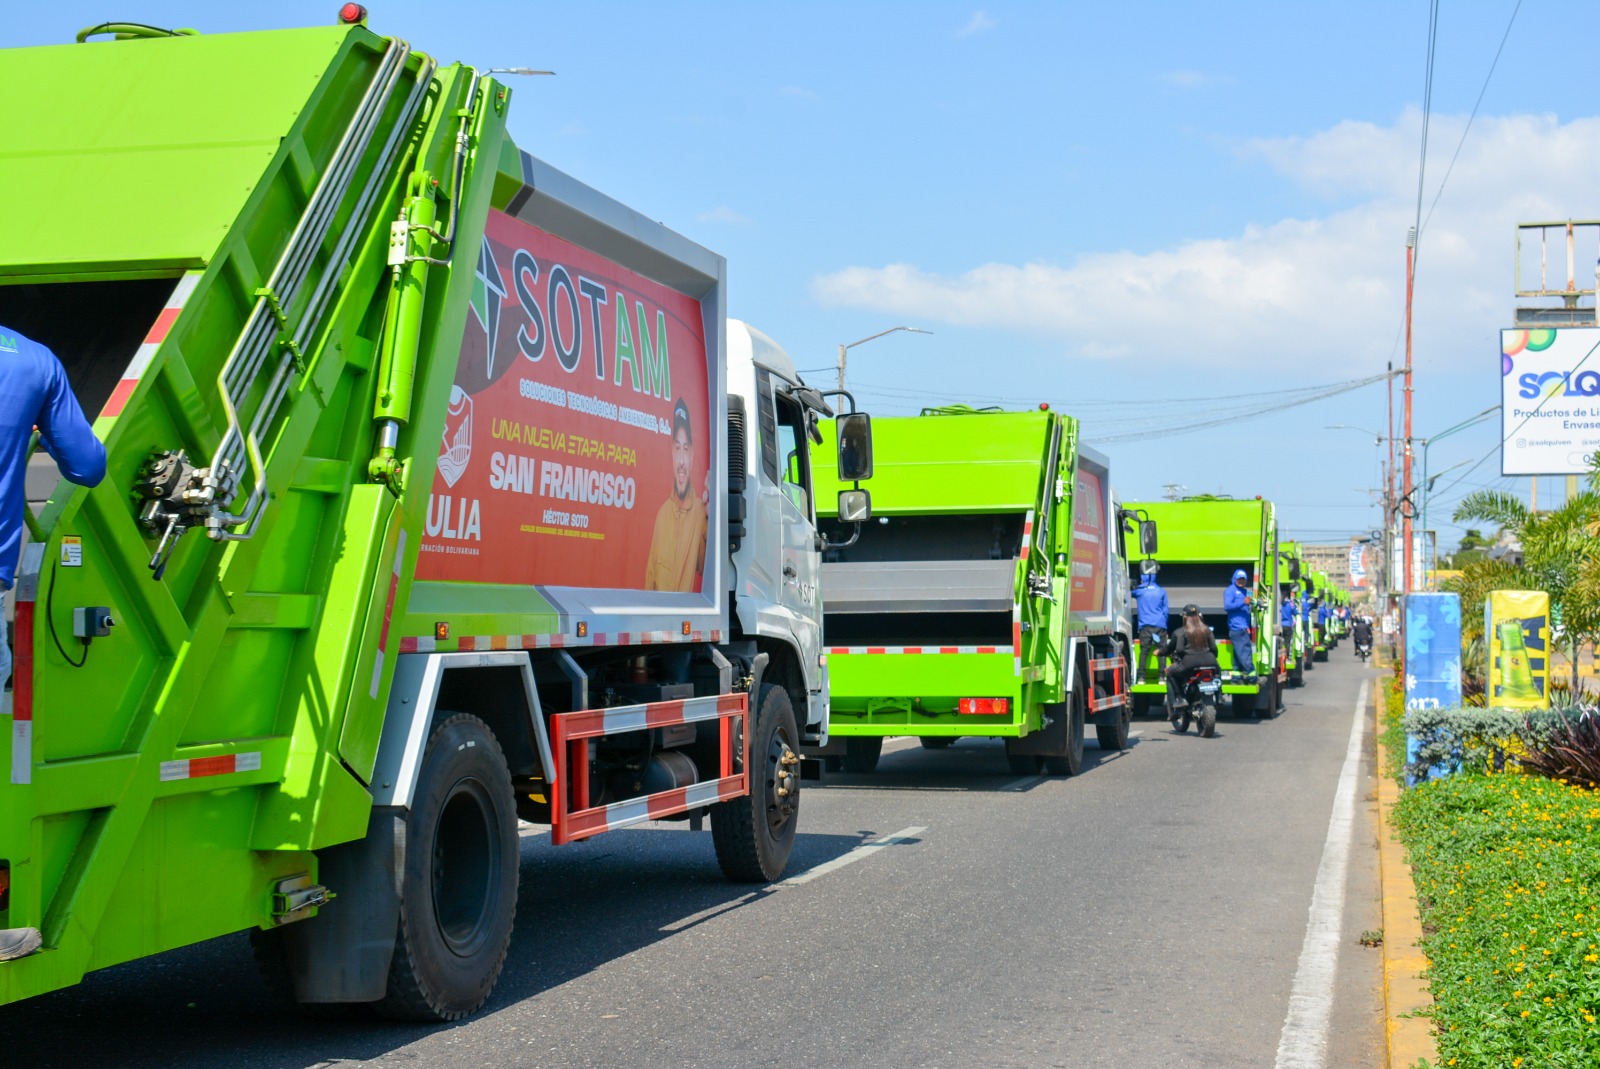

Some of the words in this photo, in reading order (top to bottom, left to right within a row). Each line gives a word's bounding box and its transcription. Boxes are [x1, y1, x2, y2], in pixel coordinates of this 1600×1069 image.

[512, 248, 672, 402] SOTAM
[519, 378, 566, 407] SOLUCIONES
[567, 391, 617, 421] TECNOLÓGICAS
[1513, 408, 1570, 418] Productos
[1573, 408, 1587, 417] de
[491, 417, 521, 443] UNA
[523, 425, 566, 453] NUEVA
[567, 435, 605, 461] ETAPA
[606, 443, 637, 467] PARA
[490, 451, 535, 495] SAN
[539, 460, 636, 510] FRANCISCO
[422, 493, 481, 541] ULIA
[542, 508, 570, 526] HÉCTOR
[571, 513, 589, 529] SOTO
